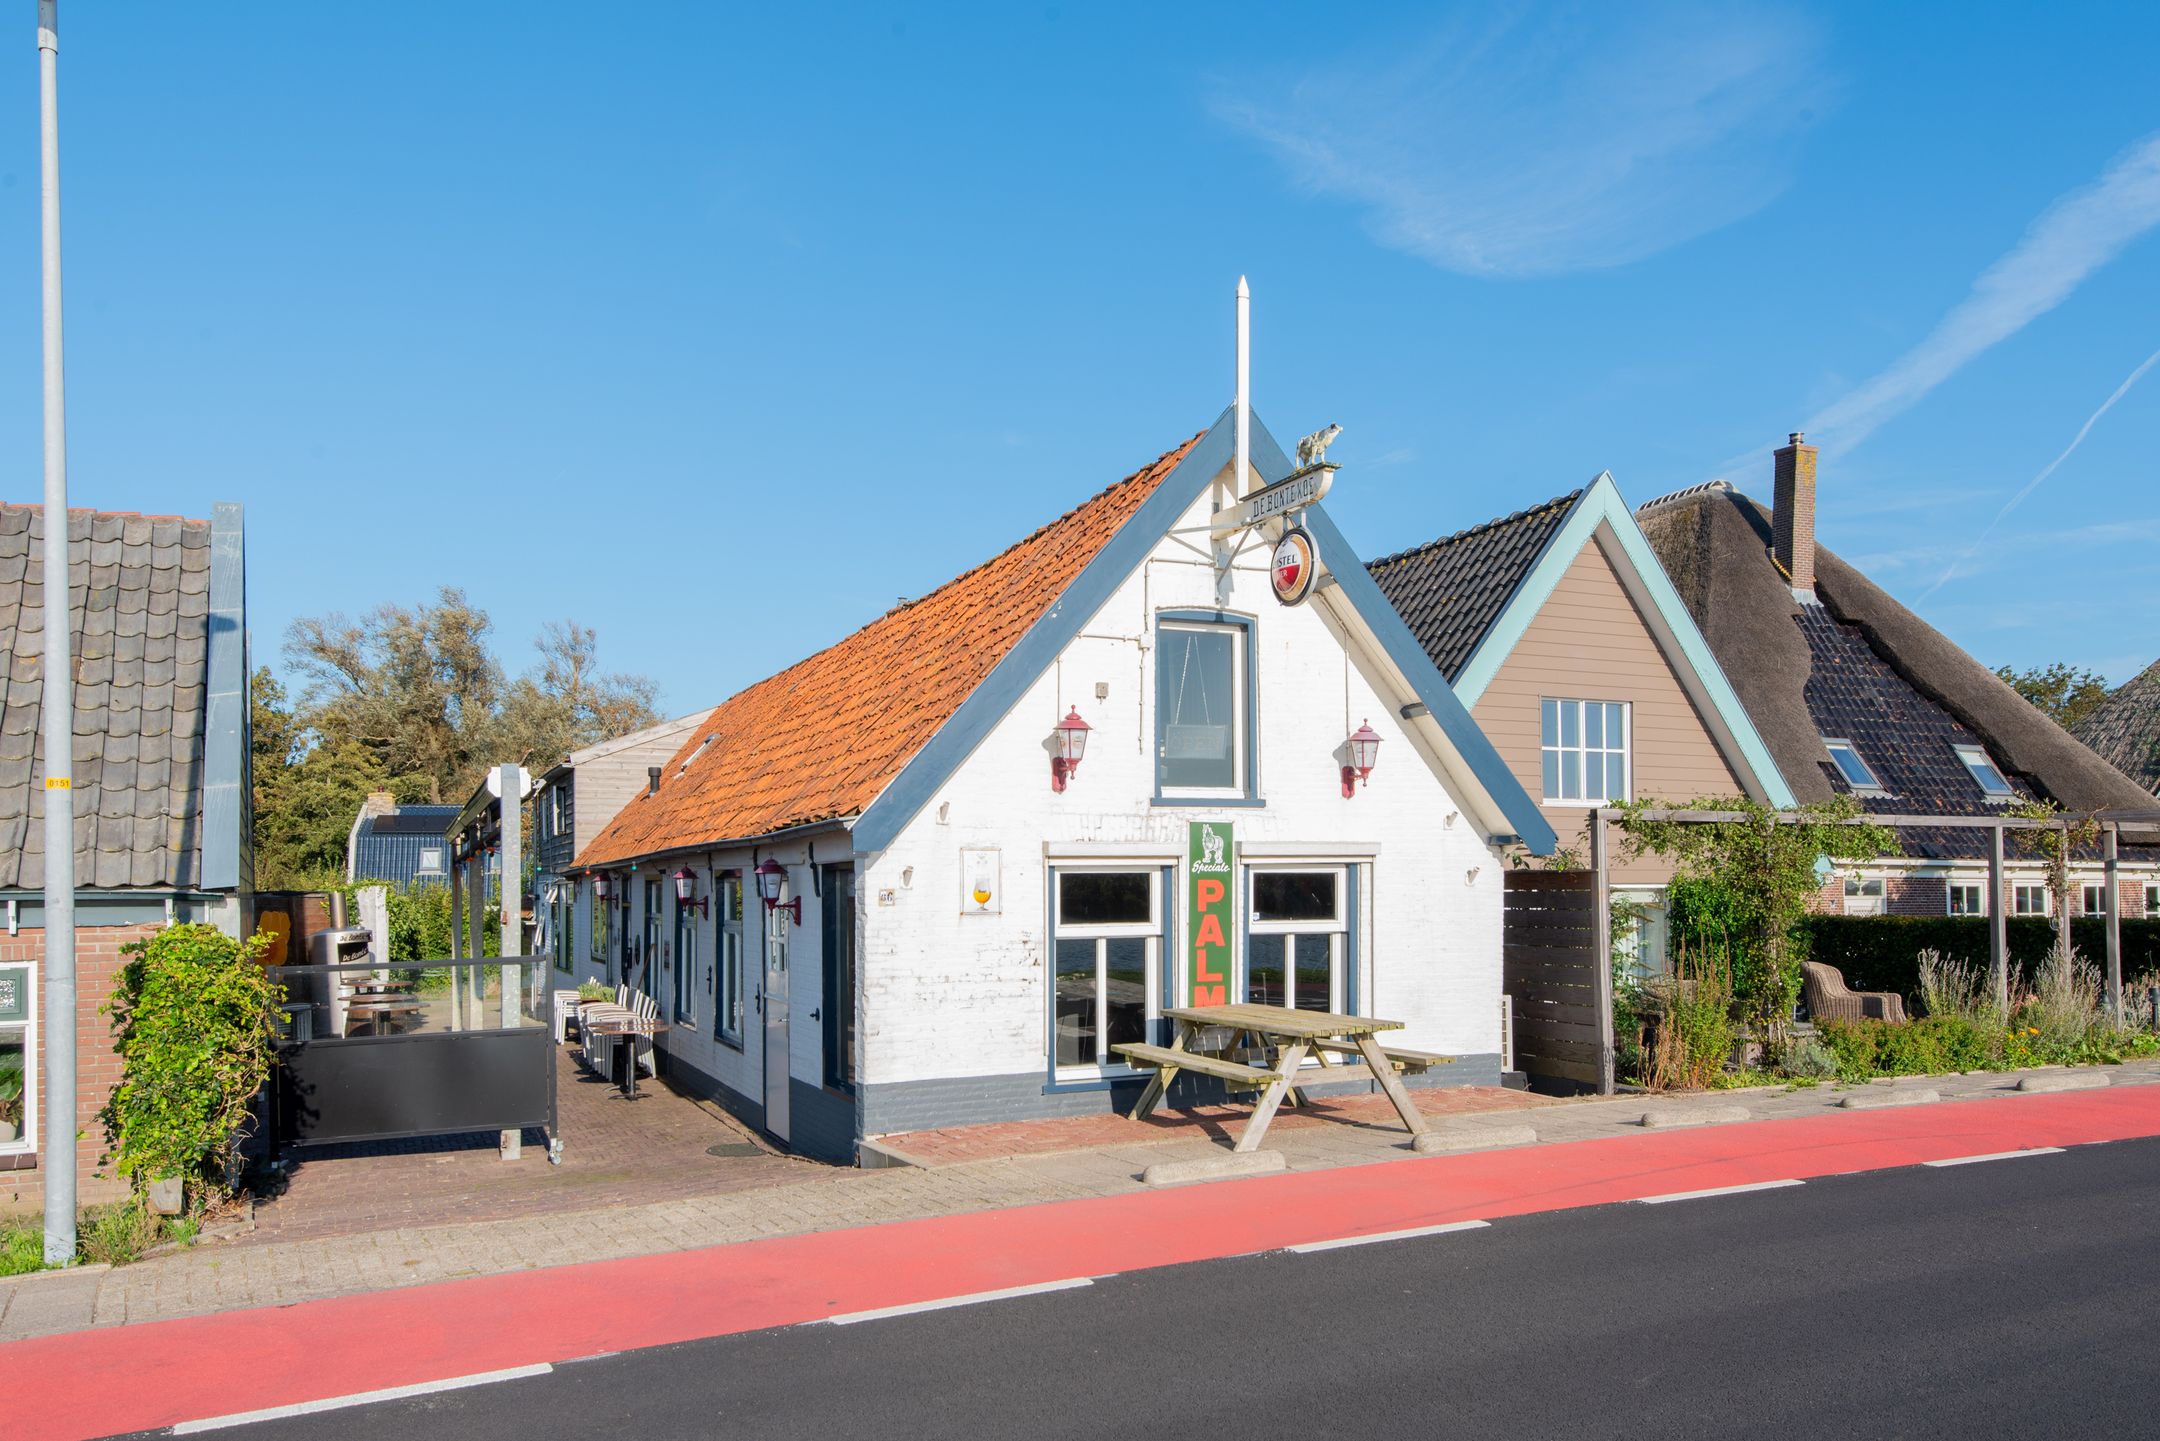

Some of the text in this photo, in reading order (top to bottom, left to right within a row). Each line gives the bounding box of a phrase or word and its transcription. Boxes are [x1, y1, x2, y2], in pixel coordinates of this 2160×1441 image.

[1253, 497, 1265, 518] DE
[1267, 485, 1295, 513] BONTE
[49, 779, 69, 787] 0151
[1191, 860, 1231, 874] Speciale
[1194, 879, 1226, 1008] PALM
